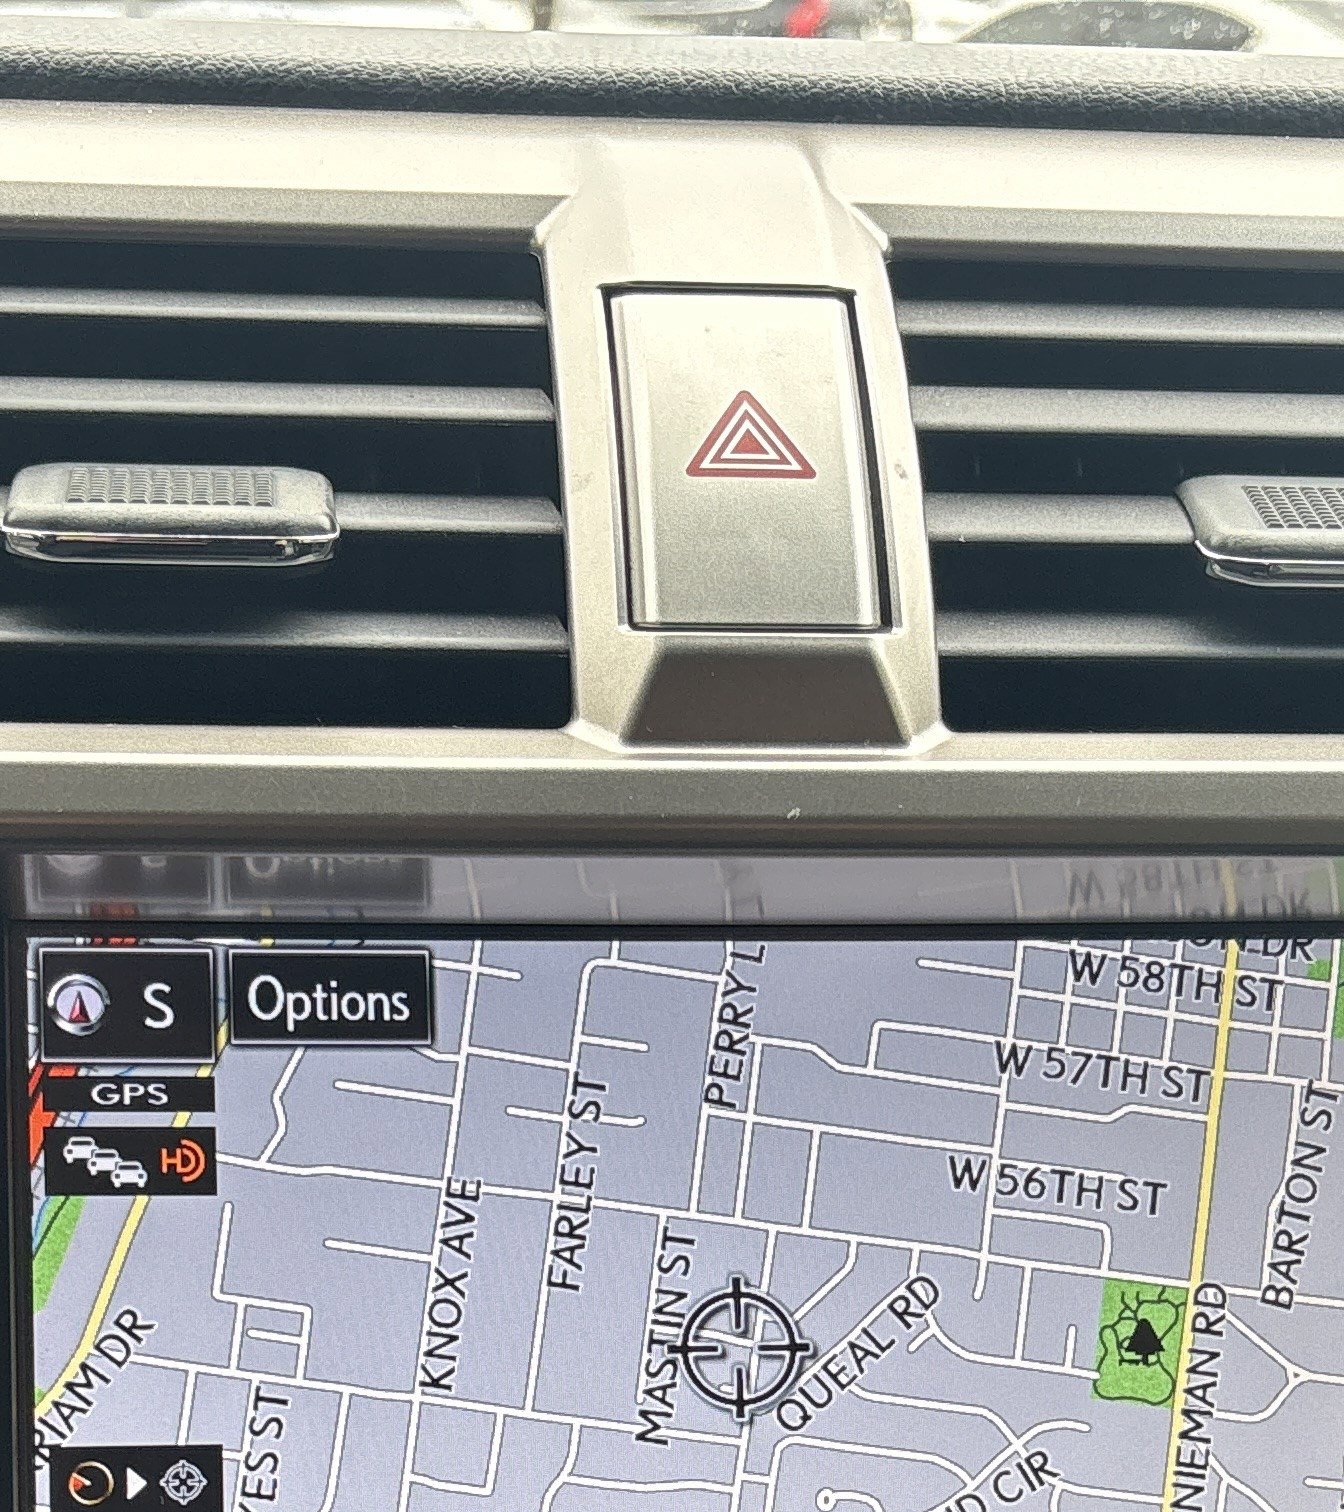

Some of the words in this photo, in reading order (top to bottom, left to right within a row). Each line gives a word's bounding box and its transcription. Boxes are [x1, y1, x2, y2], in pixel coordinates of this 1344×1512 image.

[143, 982, 175, 1029] S
[247, 974, 411, 1032] Options
[1069, 949, 1107, 987] W
[1117, 955, 1223, 1005] 58TH
[1235, 974, 1284, 1012] ST
[703, 969, 758, 1110] PERRY
[91, 1083, 169, 1105] GPS
[567, 1071, 608, 1124] ST
[995, 1040, 1034, 1078] W
[1041, 1045, 1150, 1094] 57TH
[1163, 1065, 1213, 1103] ST
[546, 1131, 599, 1293] FARLEY
[948, 1156, 989, 1192] W
[995, 1163, 1106, 1210] 56TH
[1118, 1178, 1169, 1217] ST
[1260, 1140, 1328, 1311] BARTON
[1300, 1080, 1341, 1131] ST
[439, 1176, 483, 1261] AVE
[657, 1226, 697, 1278] ST
[93, 1308, 157, 1369] DR
[419, 1266, 470, 1392] KNOX
[1194, 1281, 1228, 1338] RD
[634, 1286, 689, 1446] MASTIN
[776, 1326, 896, 1431] QUEAL
[887, 1275, 940, 1331] RD
[248, 1385, 290, 1440] ST
[1171, 1348, 1224, 1512] NIEMAN
[992, 1450, 1061, 1503] CIR
